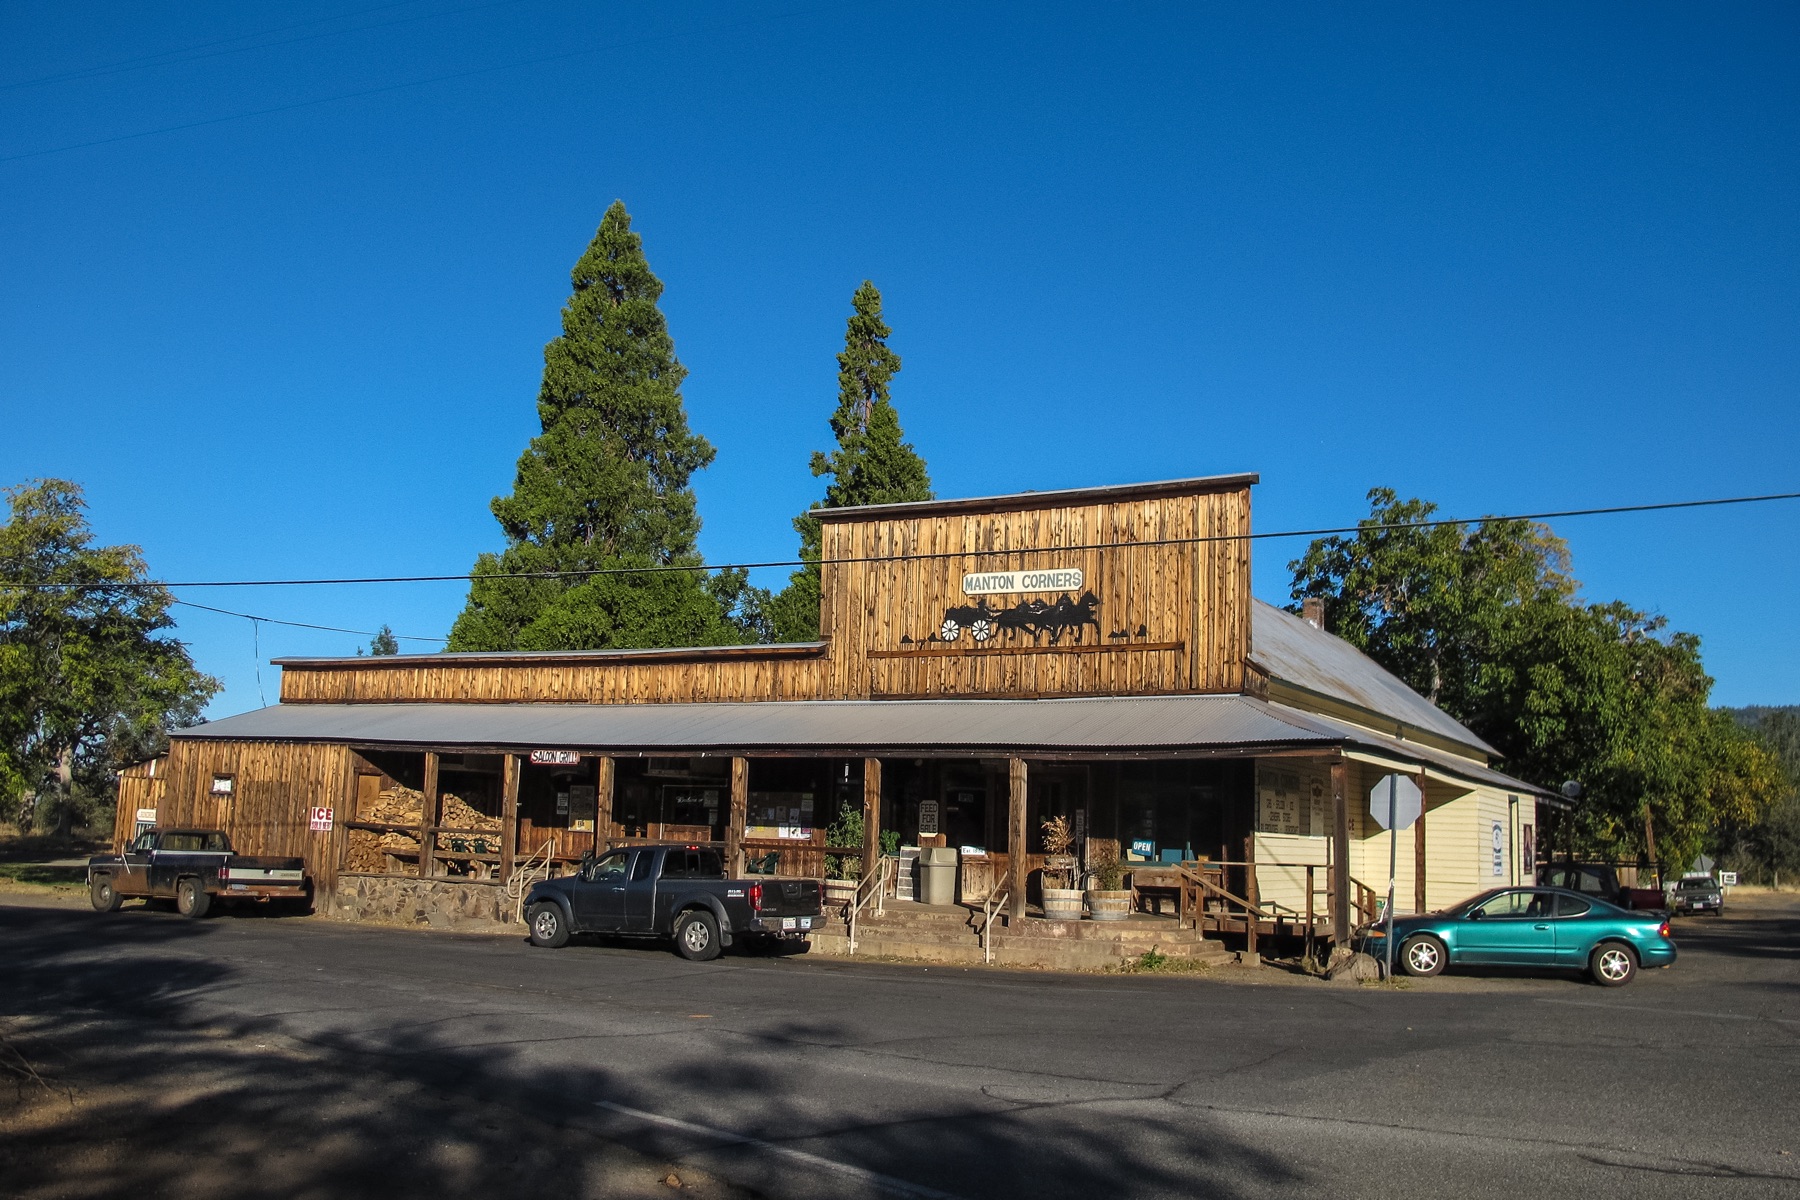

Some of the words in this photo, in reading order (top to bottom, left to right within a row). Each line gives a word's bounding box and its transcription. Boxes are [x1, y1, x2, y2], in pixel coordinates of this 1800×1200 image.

[964, 574, 1015, 592] MANTON
[1021, 571, 1082, 589] CORNERS
[531, 750, 557, 763] SALOON
[920, 804, 938, 812] FEED
[312, 808, 332, 820] ICE
[922, 814, 935, 823] FOR
[920, 824, 937, 834] SALE
[1133, 841, 1152, 852] OPEN
